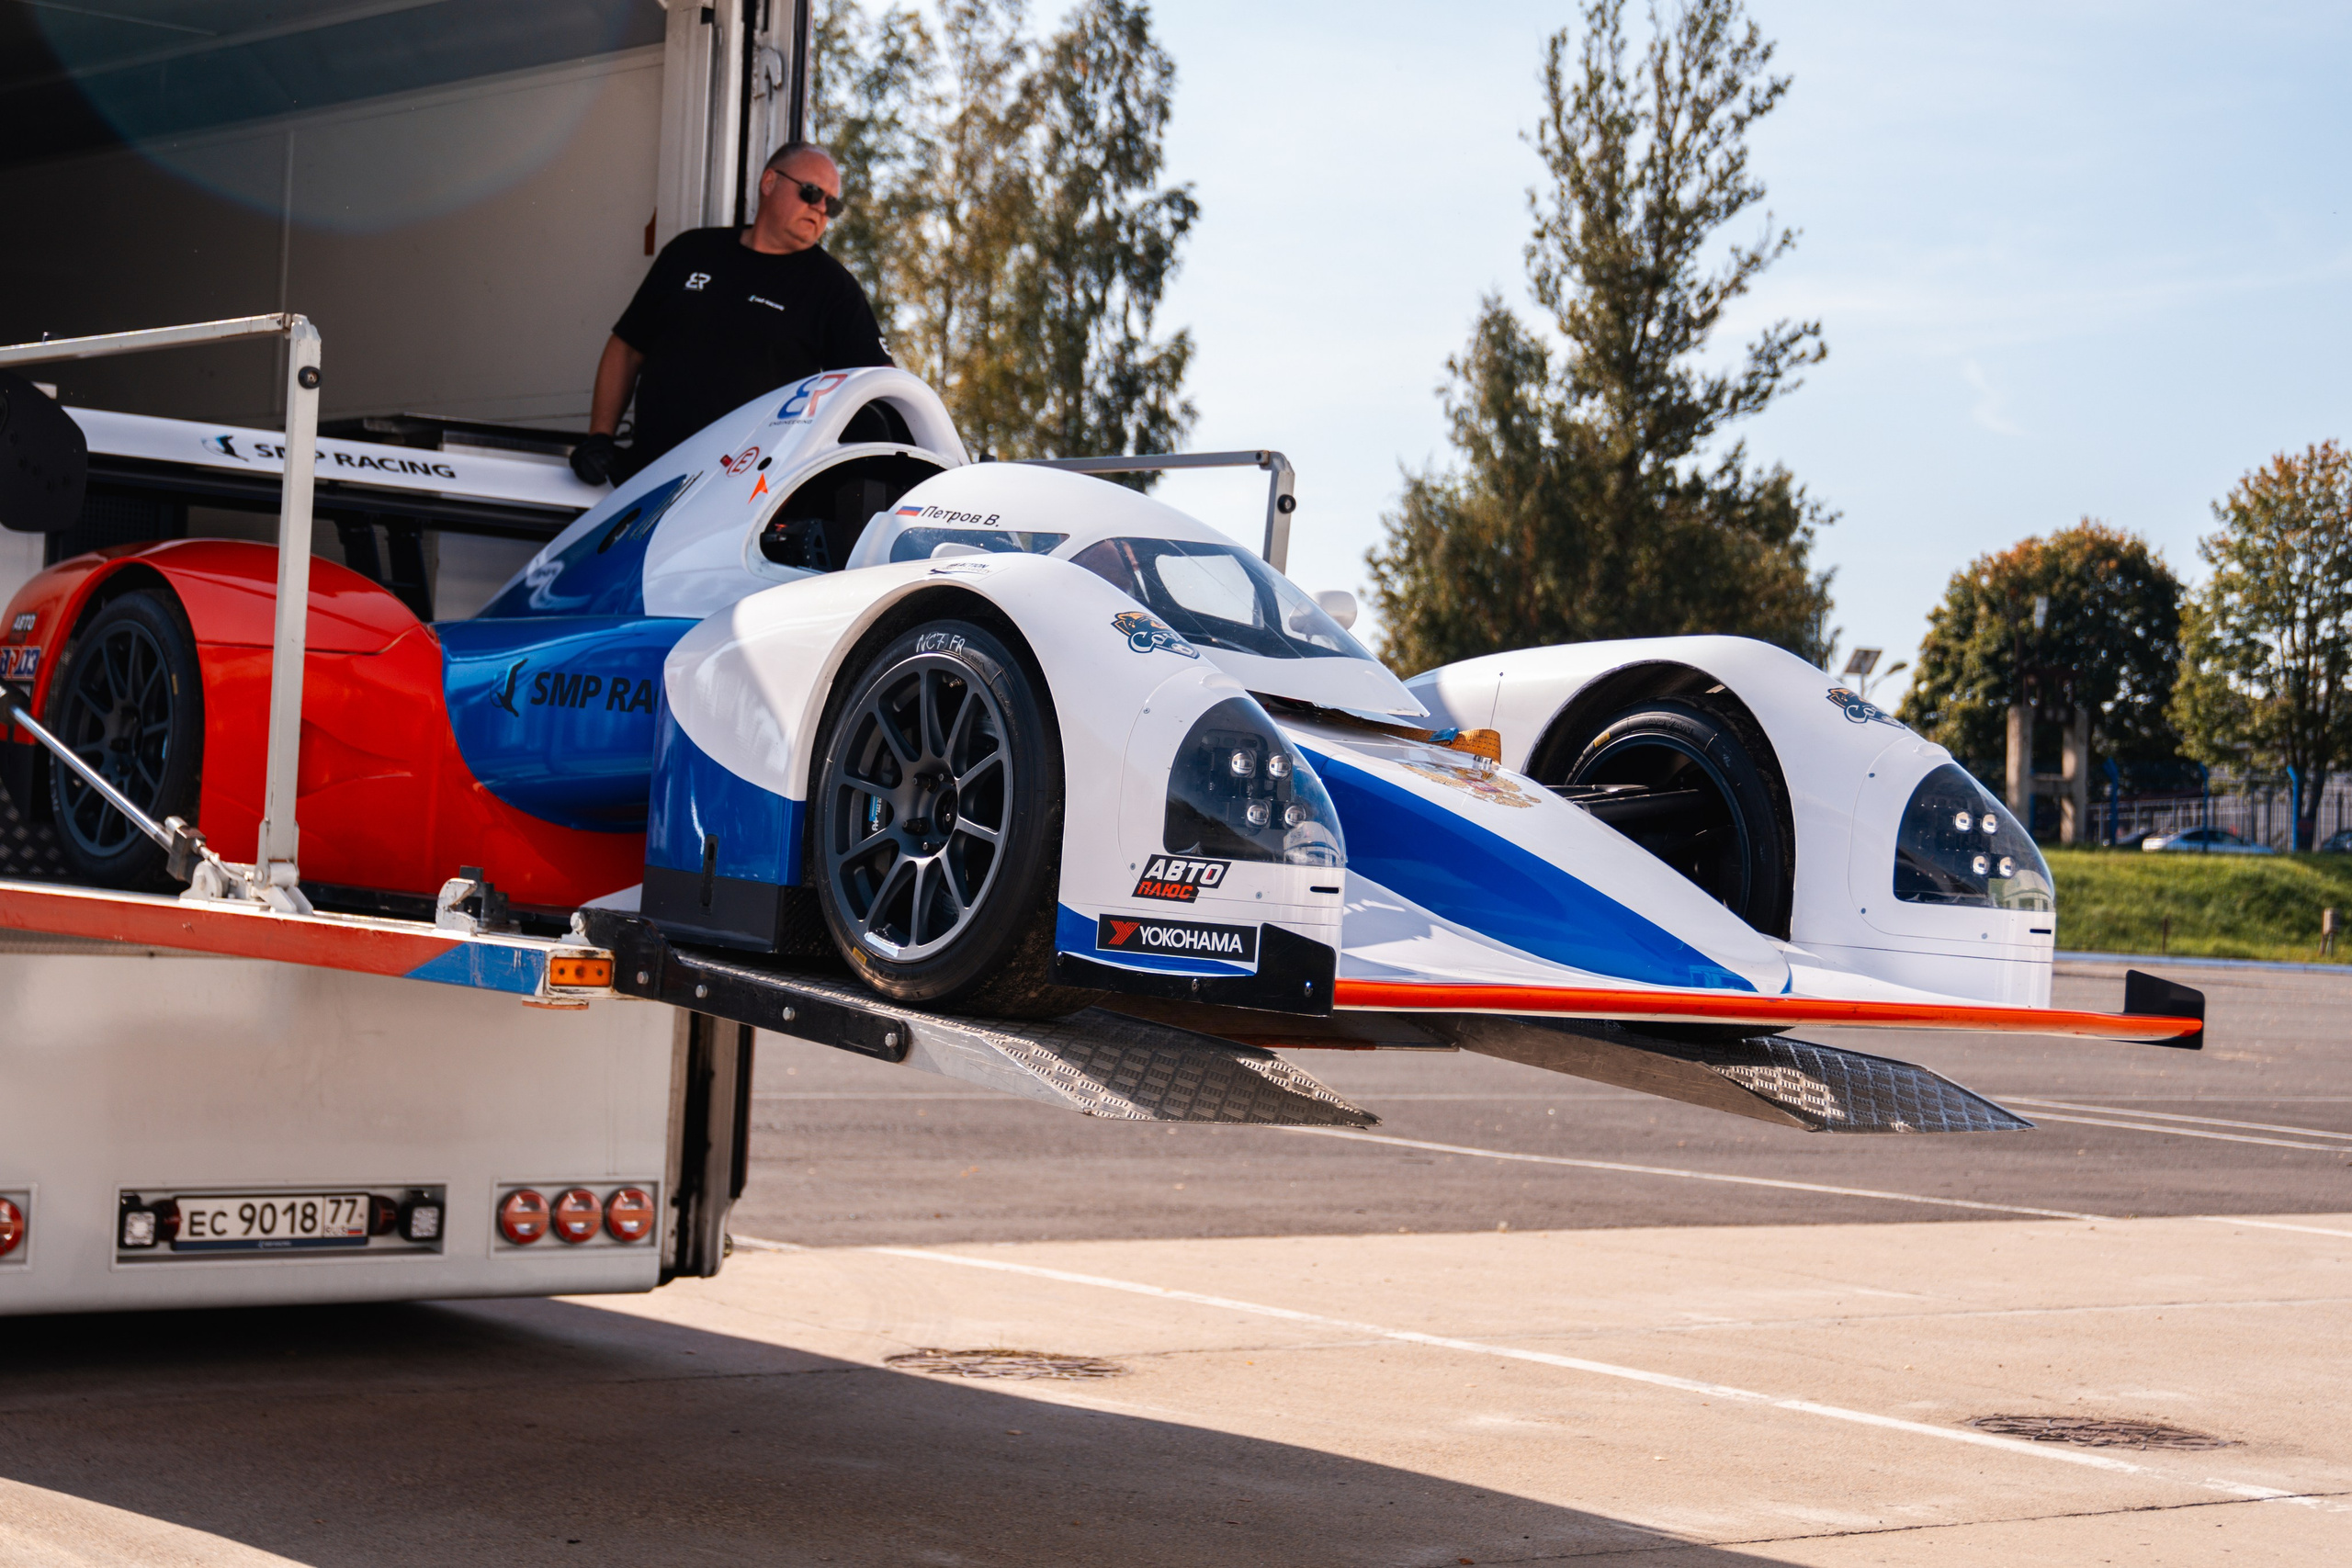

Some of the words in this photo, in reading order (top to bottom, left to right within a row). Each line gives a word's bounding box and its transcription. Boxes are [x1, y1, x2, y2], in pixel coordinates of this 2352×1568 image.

[334, 452, 457, 479] RACING
[921, 505, 982, 524] Петров
[983, 513, 1001, 527] В.
[948, 634, 966, 657] FR
[529, 671, 602, 708] SMP
[605, 677, 660, 714] RA
[1145, 859, 1225, 885] АВТО
[1136, 881, 1193, 899] ПЛЮС
[1139, 925, 1244, 953] YOKOHAMA
[239, 1201, 318, 1235] 9018
[328, 1198, 357, 1224] 77
